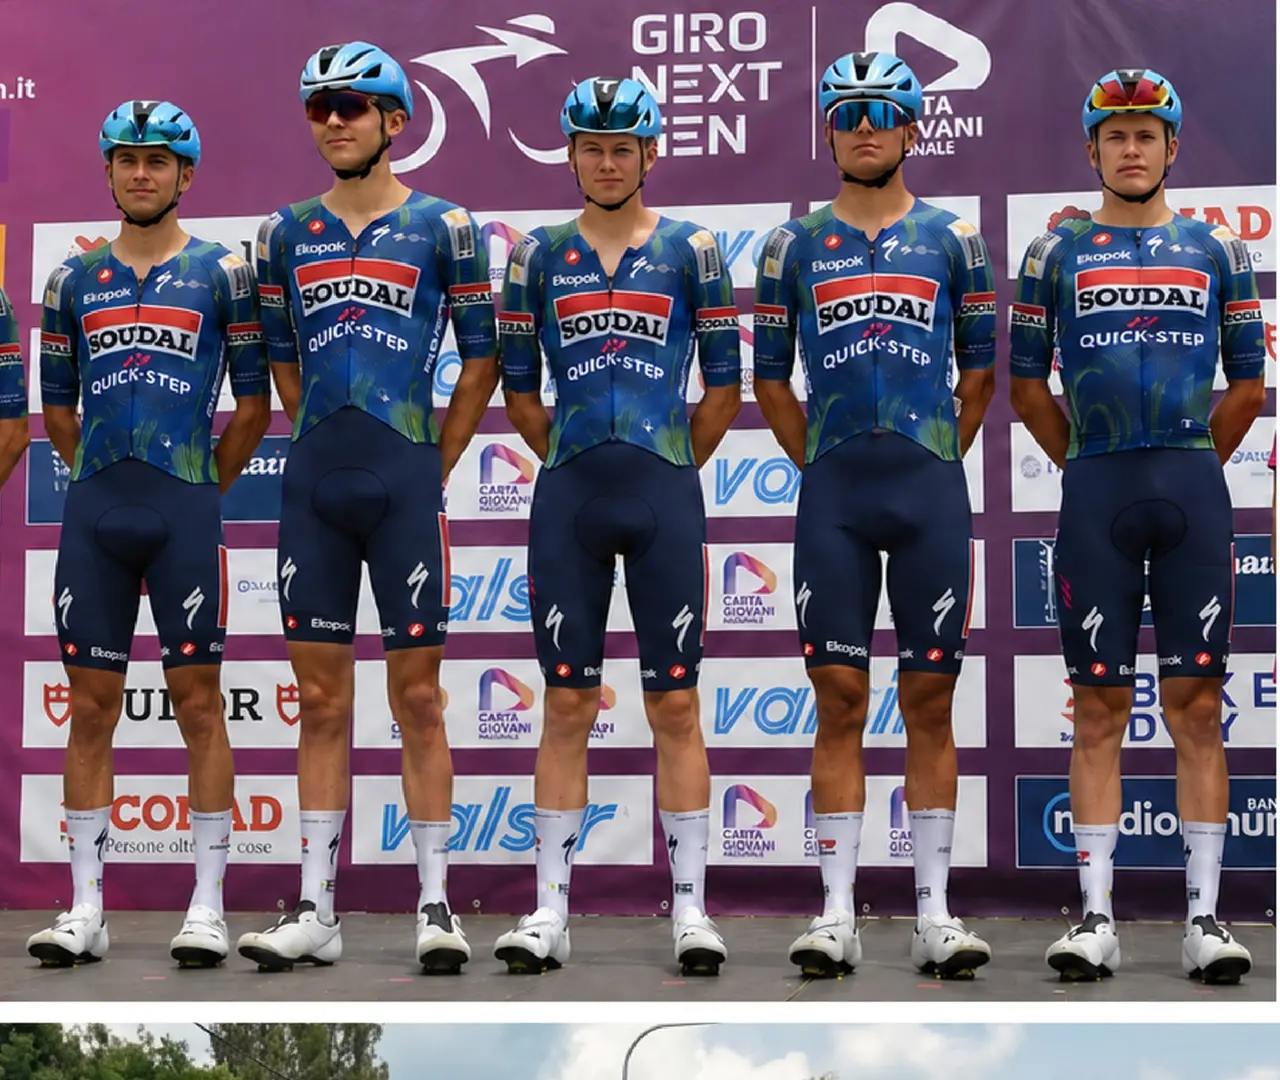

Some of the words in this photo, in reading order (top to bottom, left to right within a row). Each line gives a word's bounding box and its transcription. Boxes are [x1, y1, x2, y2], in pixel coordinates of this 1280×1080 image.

[632, 11, 767, 55] GIRO
[632, 61, 782, 104] NEXT
[657, 115, 747, 157] EN
[1180, 205, 1272, 242] AD
[302, 278, 410, 312] SOUDAL
[1078, 288, 1205, 311] SOUDAL
[818, 294, 931, 328] SOUDAL
[89, 325, 194, 354] SOUDAL
[561, 312, 665, 340] SOUDAL
[478, 713, 519, 723] CARTA
[478, 723, 532, 734] GIOVANI
[105, 837, 165, 855] Persone
[237, 840, 273, 854] cose
[723, 840, 776, 851] GIOVANI
